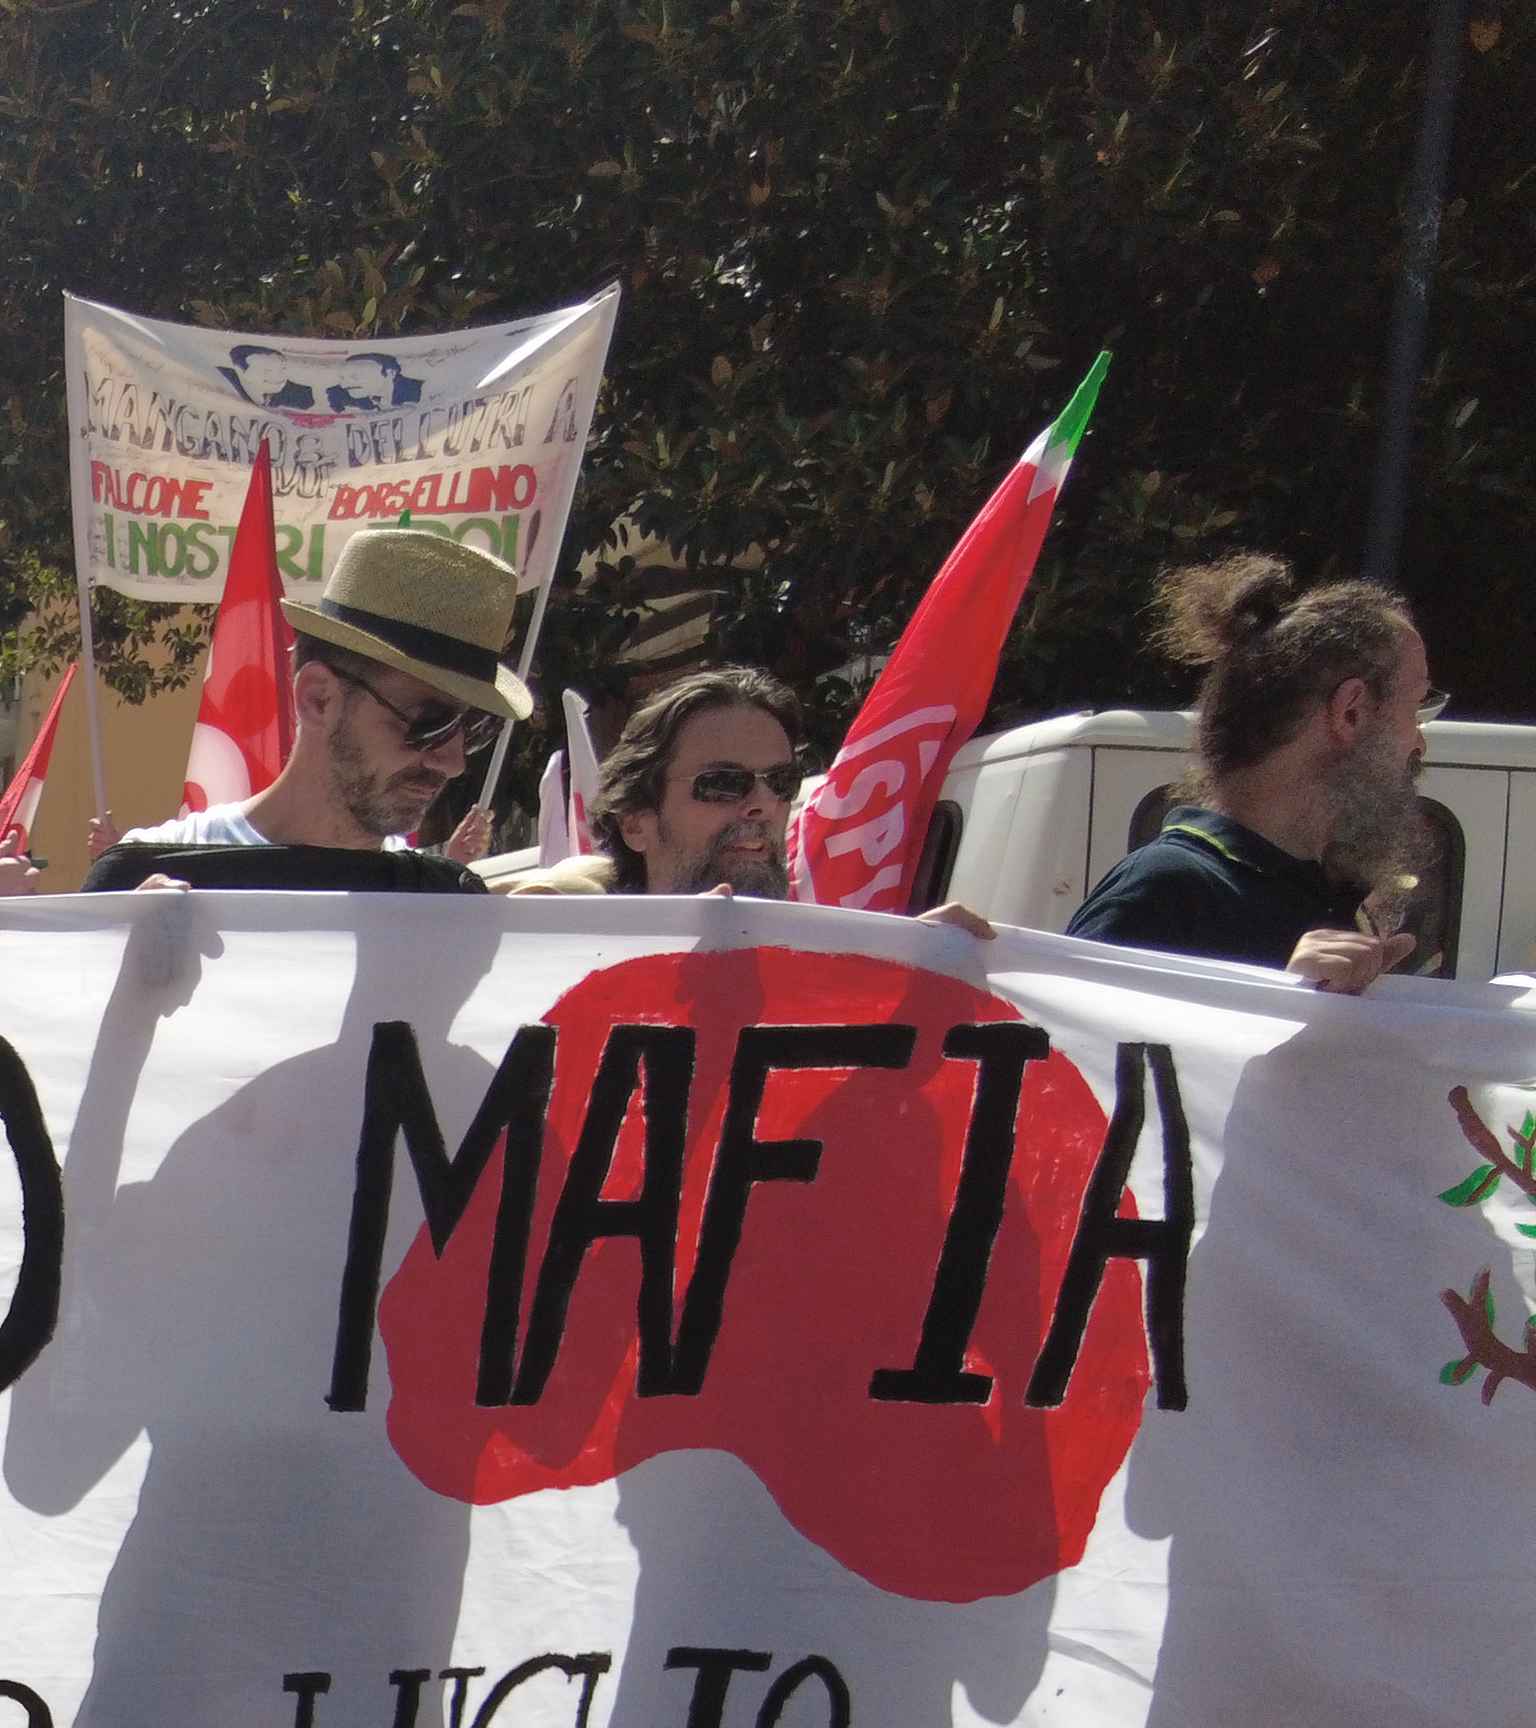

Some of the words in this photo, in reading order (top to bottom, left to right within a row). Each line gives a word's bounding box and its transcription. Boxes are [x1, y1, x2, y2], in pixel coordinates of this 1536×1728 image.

[85, 372, 286, 468] MANGANO
[544, 377, 579, 444] A
[91, 461, 214, 520] FALCONE
[328, 464, 537, 520] BORSELLINO
[104, 513, 116, 569] I
[325, 1021, 1195, 1413] MAFIA
